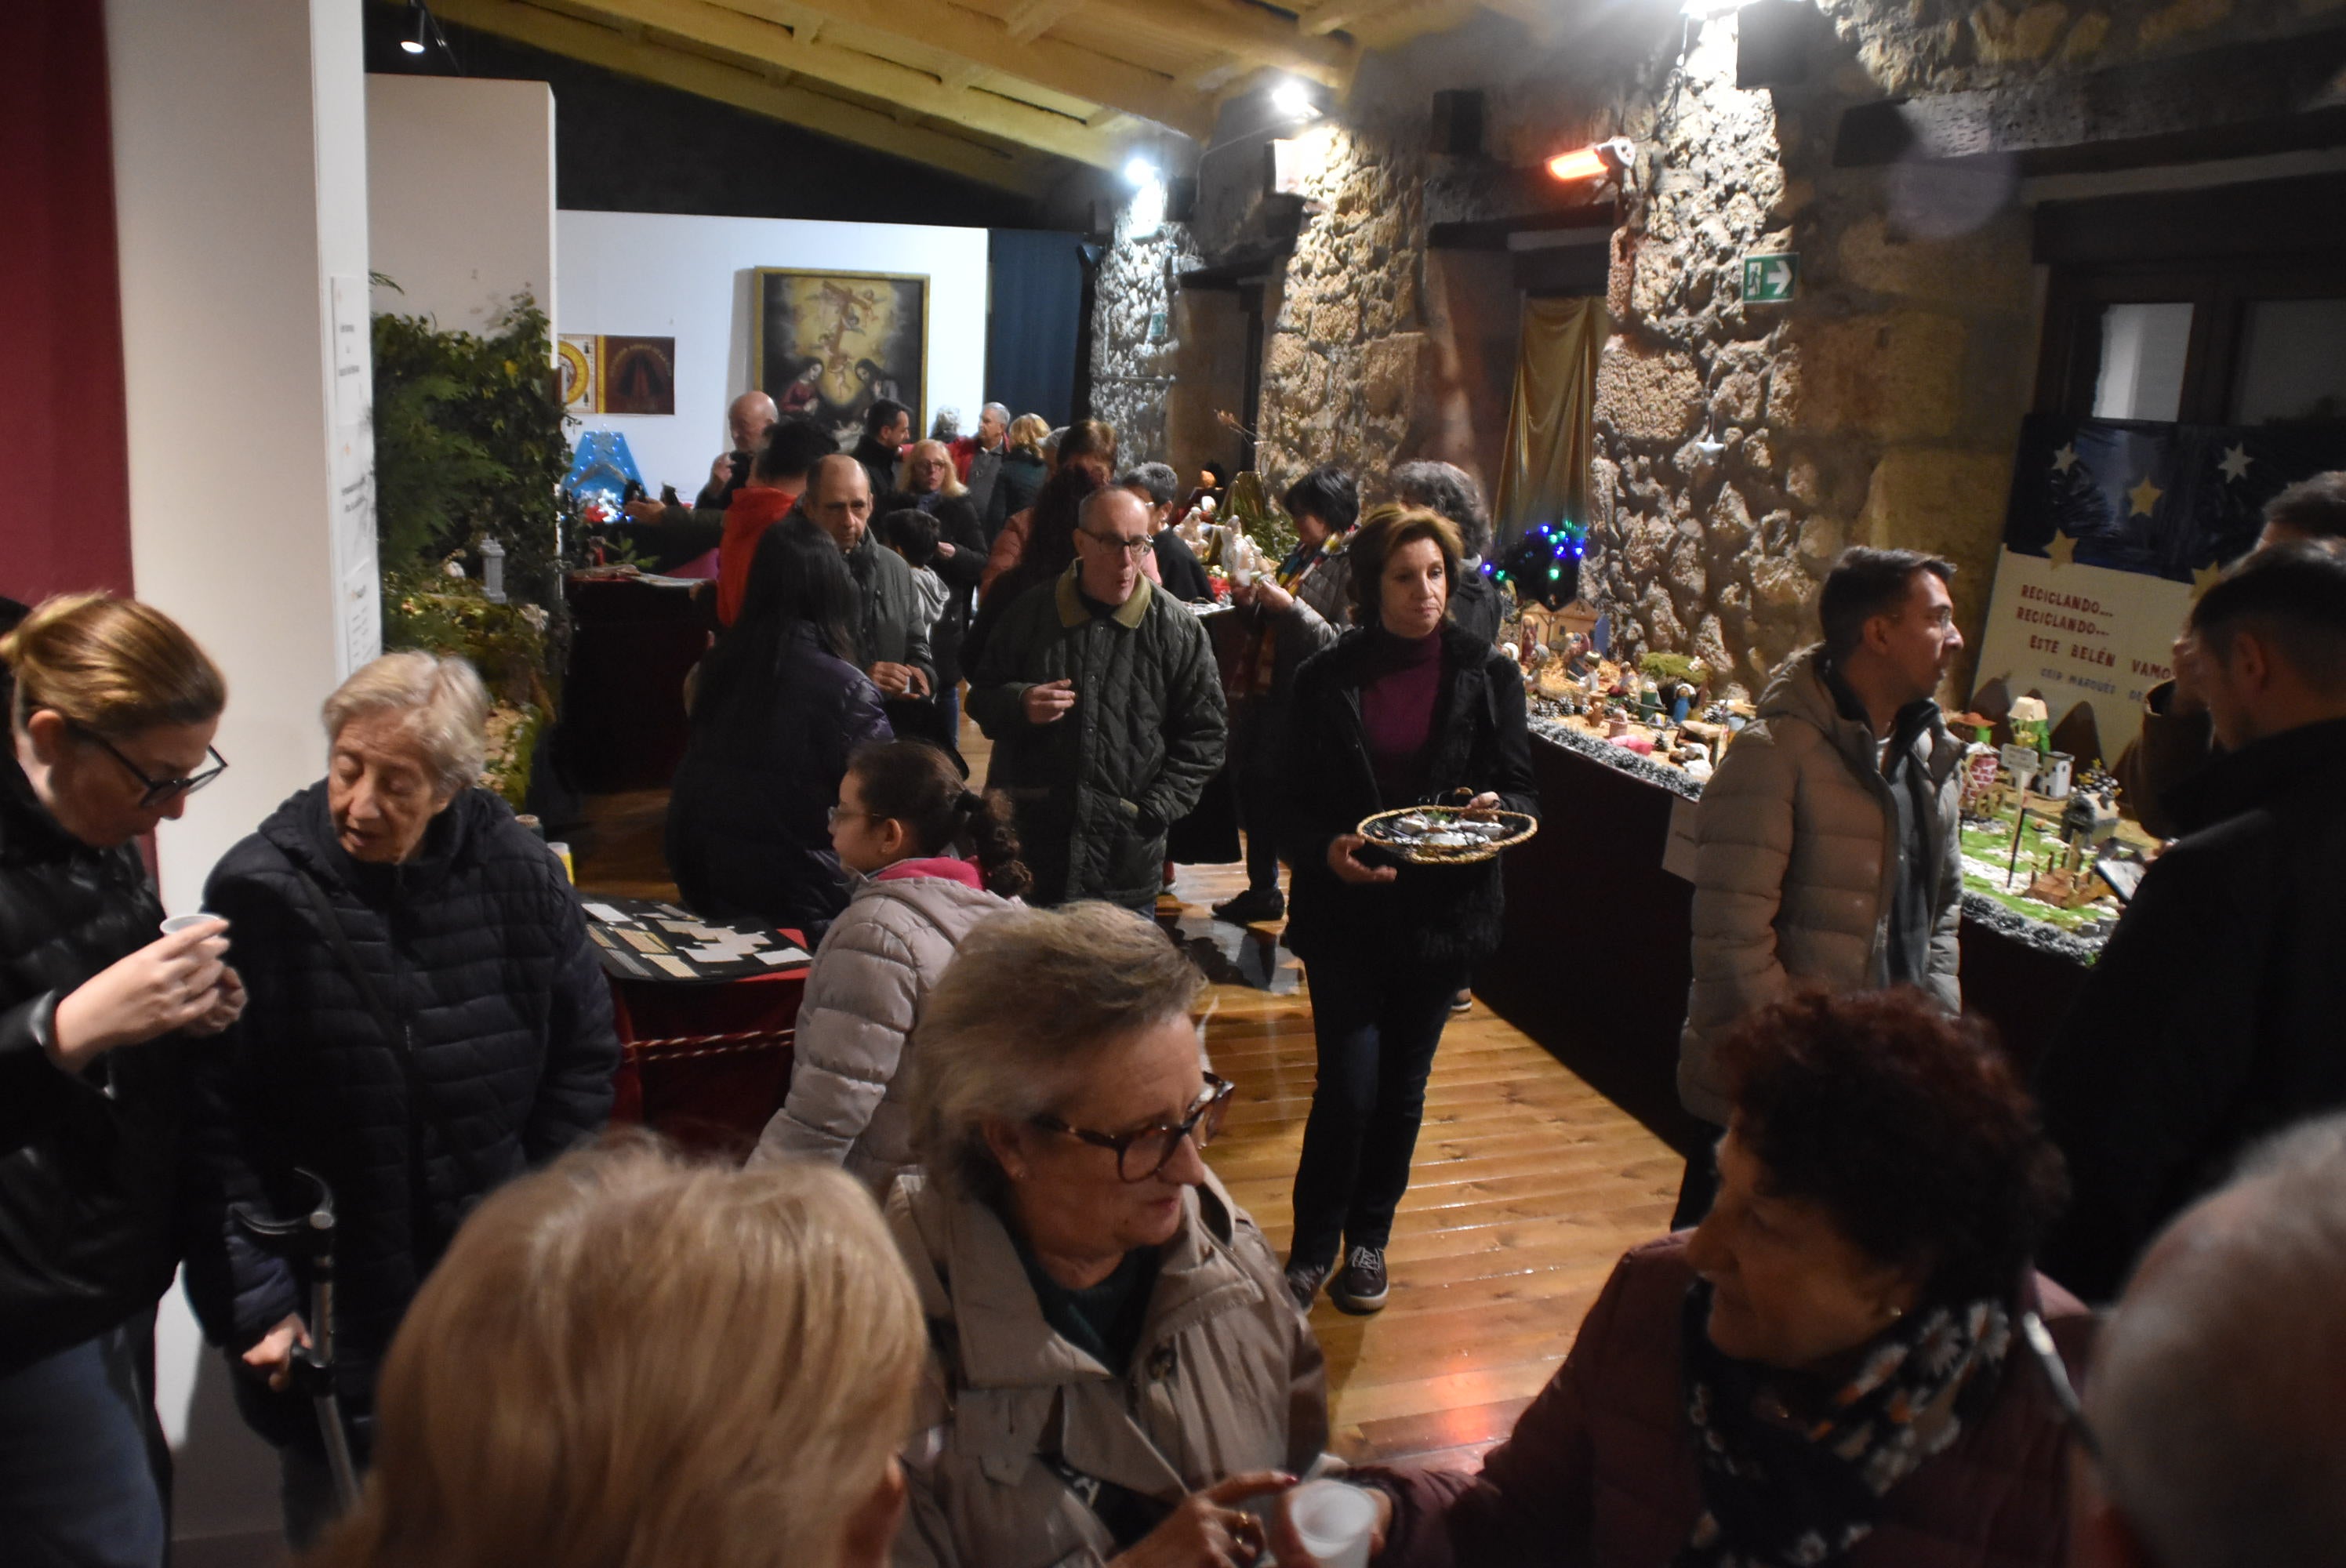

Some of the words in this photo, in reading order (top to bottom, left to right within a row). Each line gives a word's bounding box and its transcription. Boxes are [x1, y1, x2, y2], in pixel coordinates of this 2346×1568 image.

[2021, 584, 2113, 617] RECICLANDO...
[2016, 606, 2109, 636] RECICLANDO...
[2030, 634, 2060, 654] ESTE
[2071, 644, 2116, 667] BELÉN
